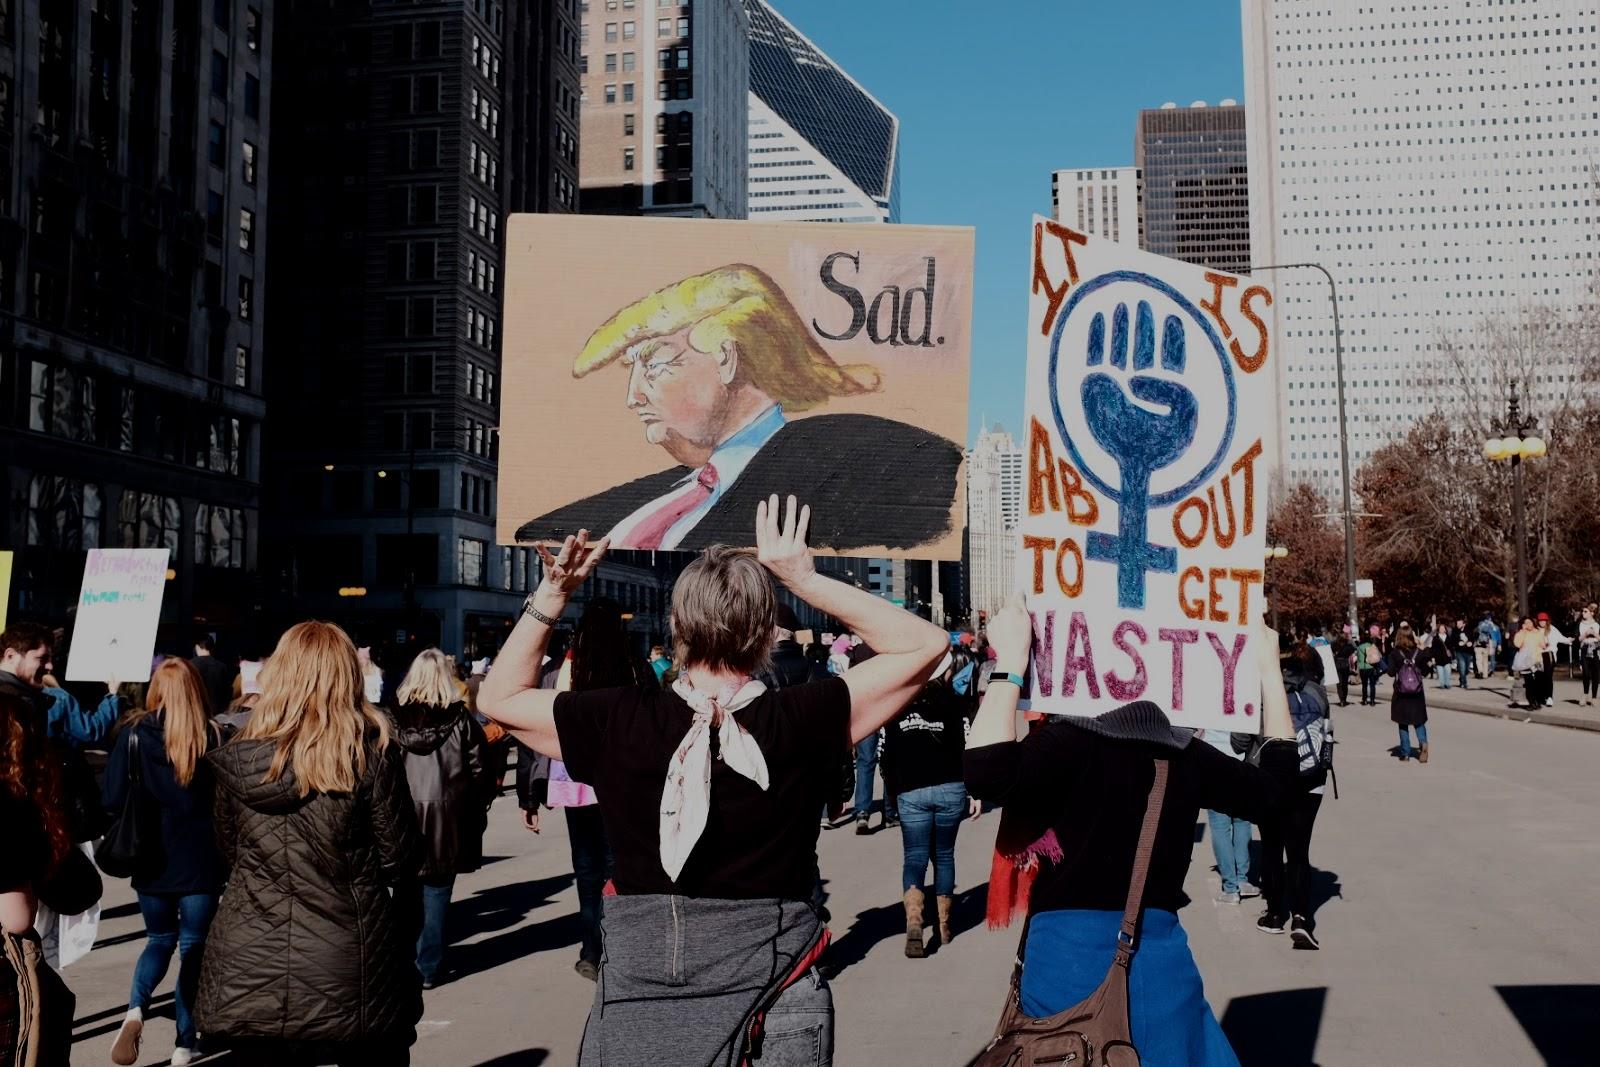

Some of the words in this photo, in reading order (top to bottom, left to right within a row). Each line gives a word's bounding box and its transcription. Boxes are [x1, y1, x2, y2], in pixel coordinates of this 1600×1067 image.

[812, 250, 945, 347] Sad.
[1032, 221, 1088, 336] IT
[1200, 271, 1273, 374] IS
[1023, 535, 1084, 598] TO
[1178, 566, 1263, 627] GET
[1029, 609, 1255, 716] NASTY.
